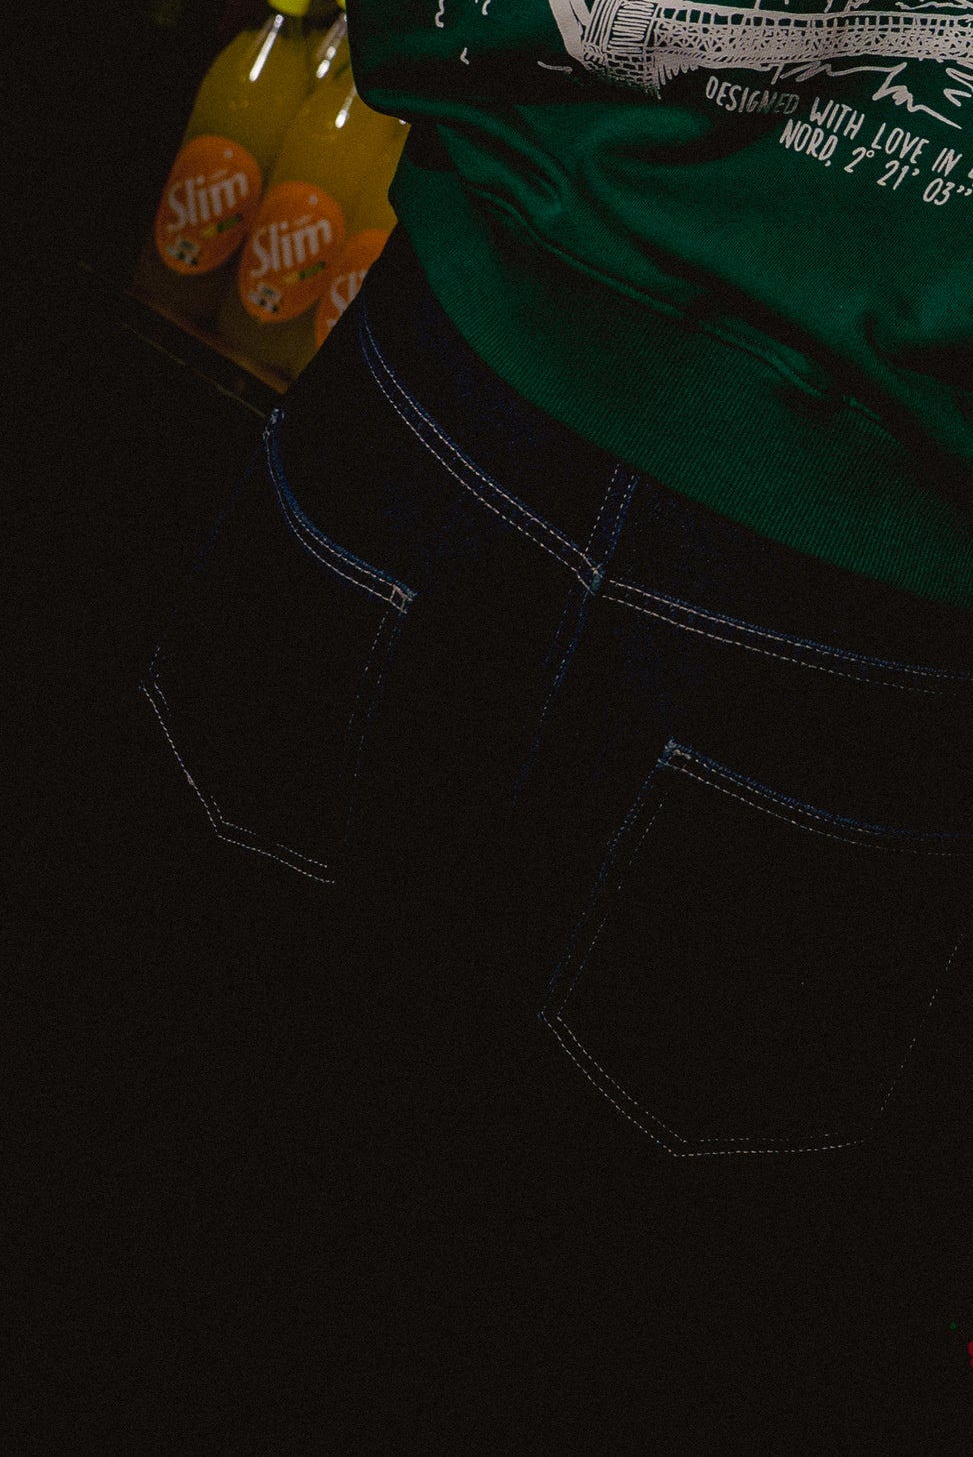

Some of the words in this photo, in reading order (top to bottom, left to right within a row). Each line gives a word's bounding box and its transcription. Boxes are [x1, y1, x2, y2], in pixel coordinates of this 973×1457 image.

[705, 75, 800, 114] DESIGNED
[809, 96, 865, 140] WITH
[871, 122, 930, 164] LOVE
[931, 147, 963, 177] IN
[779, 118, 838, 167] NORD,
[843, 146, 875, 173] 2°
[166, 170, 249, 233] Slim
[249, 216, 333, 279] Slim
